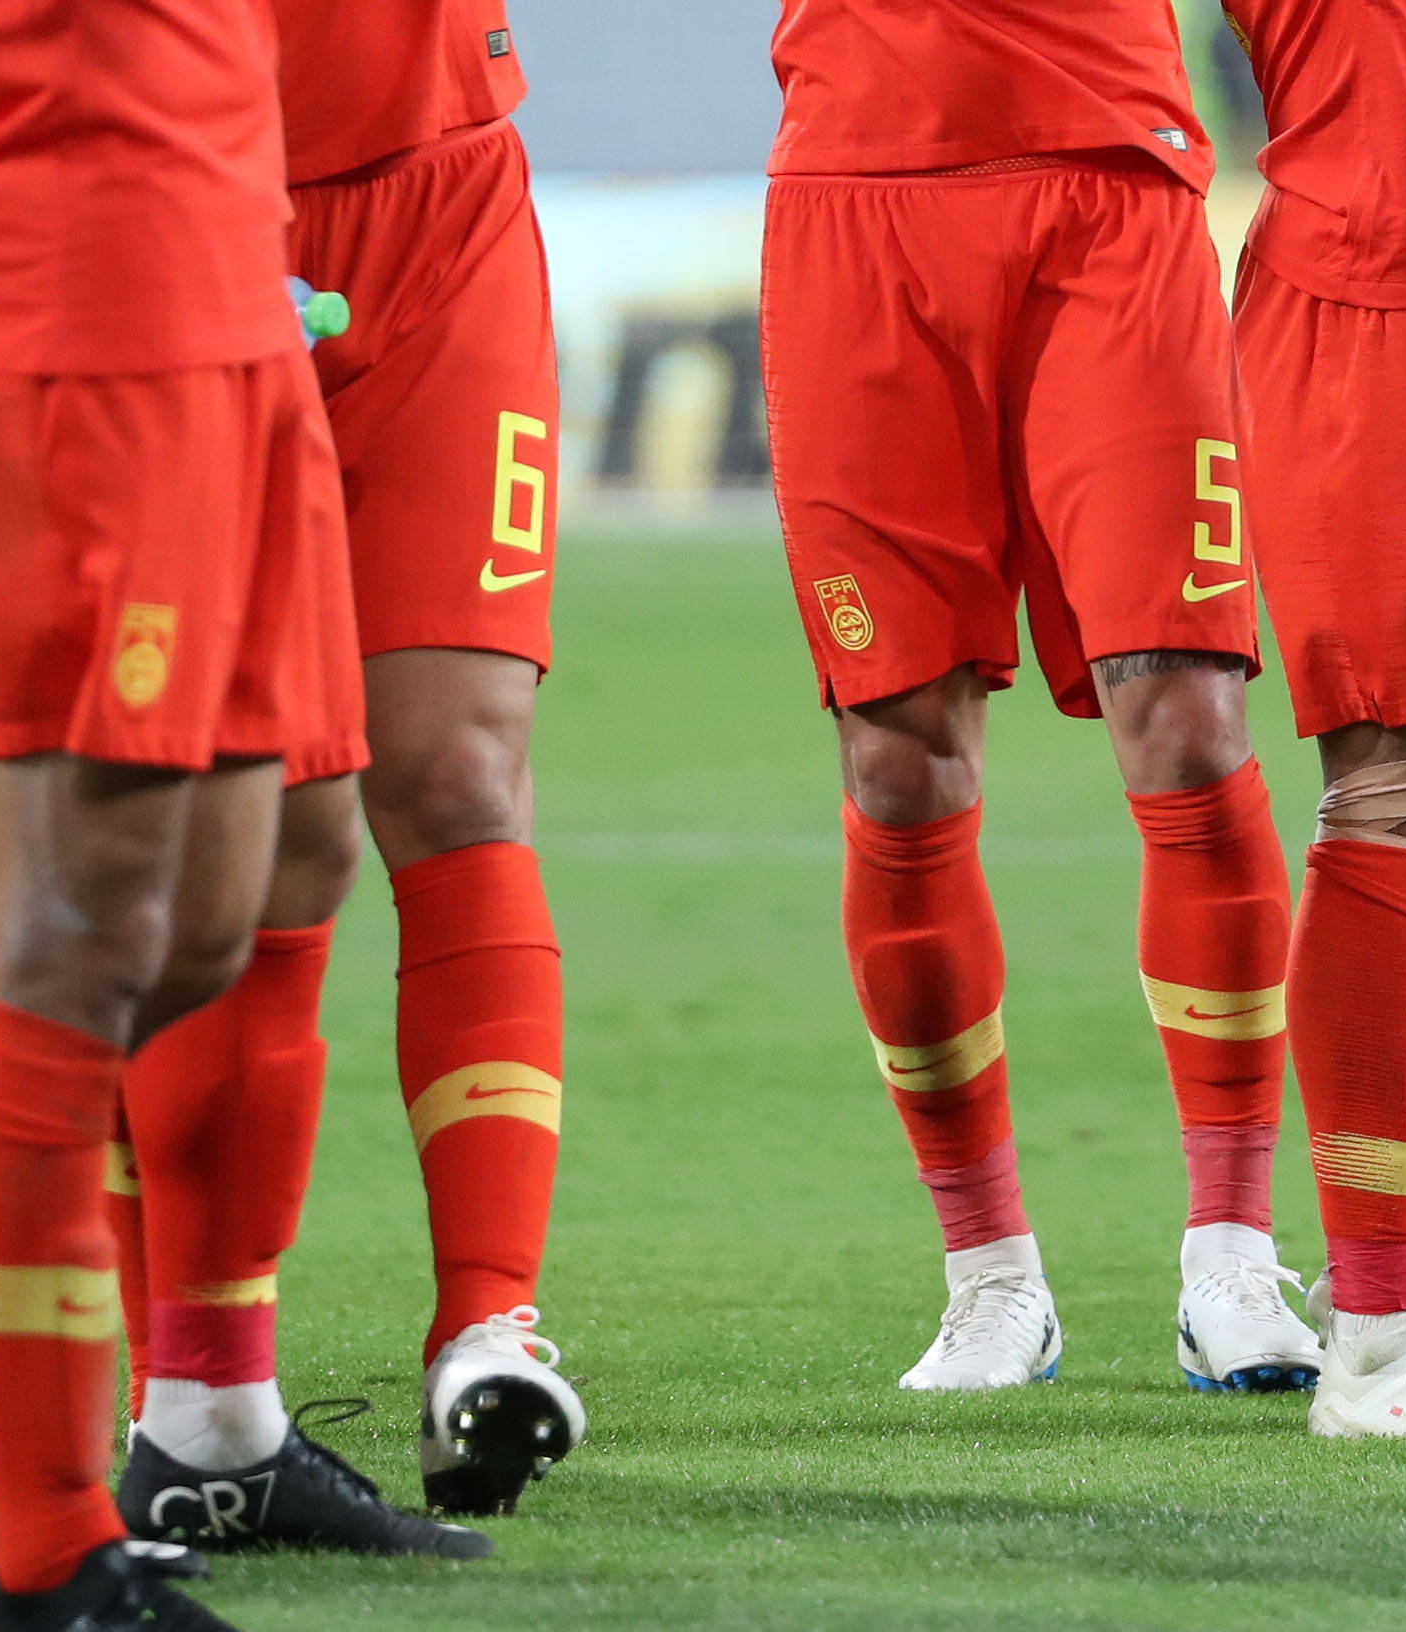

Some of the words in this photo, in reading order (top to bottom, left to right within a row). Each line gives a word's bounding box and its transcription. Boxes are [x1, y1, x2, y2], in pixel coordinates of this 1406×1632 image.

[491, 410, 547, 554] 6
[1193, 437, 1243, 567] 5
[819, 580, 856, 599] CFA
[149, 1470, 276, 1537] CR7
